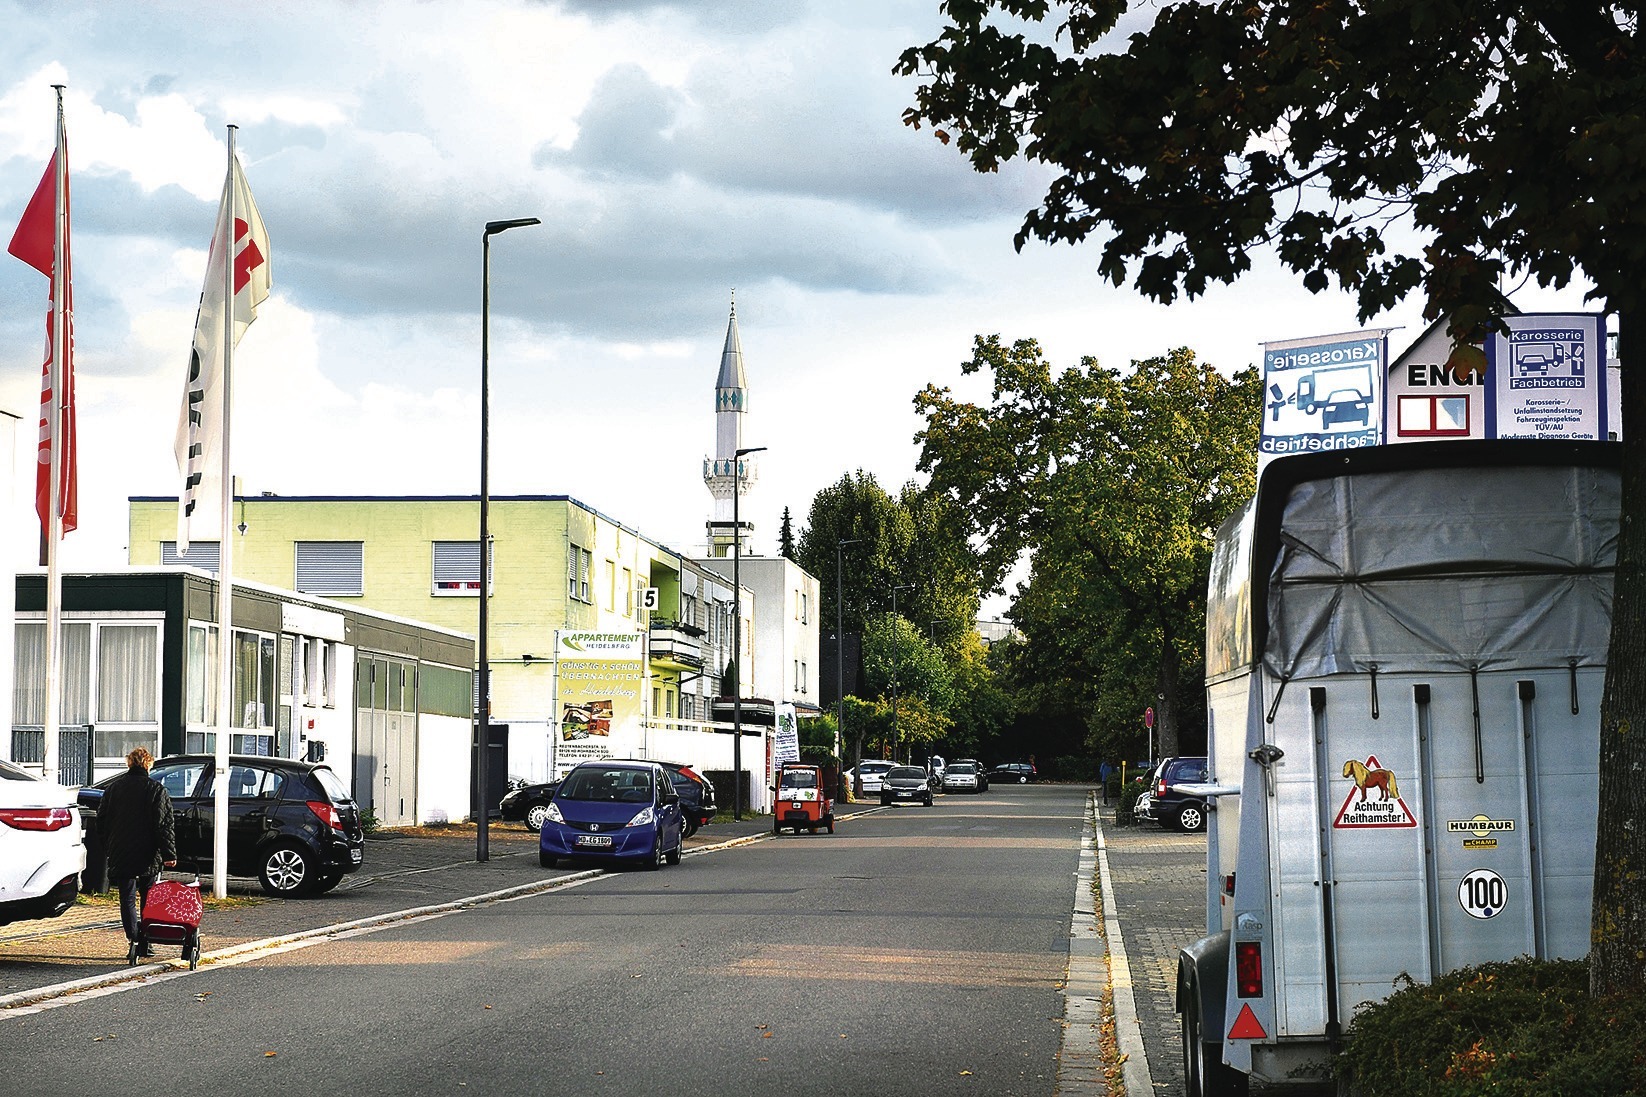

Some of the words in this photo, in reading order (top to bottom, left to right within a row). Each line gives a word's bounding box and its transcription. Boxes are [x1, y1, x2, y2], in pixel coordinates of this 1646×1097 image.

[1511, 331, 1582, 341] Karosserie
[1512, 378, 1583, 388] Fachbetrieb
[1513, 407, 1583, 416] Unfallinstandsetzung
[1516, 416, 1581, 424] Fahrzeuginspektion
[1534, 423, 1564, 431] TÜV/AU
[645, 590, 656, 608] 5
[728, 601, 736, 614] 7
[571, 633, 640, 643] APPARTEMENT
[561, 661, 599, 670] GÜNSTIG
[610, 661, 640, 671] SCHÖN
[561, 671, 640, 681] ÜBERNACHTEN
[563, 686, 574, 695] in
[579, 681, 637, 699] Heidelberg
[1354, 802, 1394, 813] Achtung
[1343, 813, 1406, 824] Reithamster!
[1450, 822, 1513, 830] HUMBAUR
[1463, 877, 1504, 909] 100
